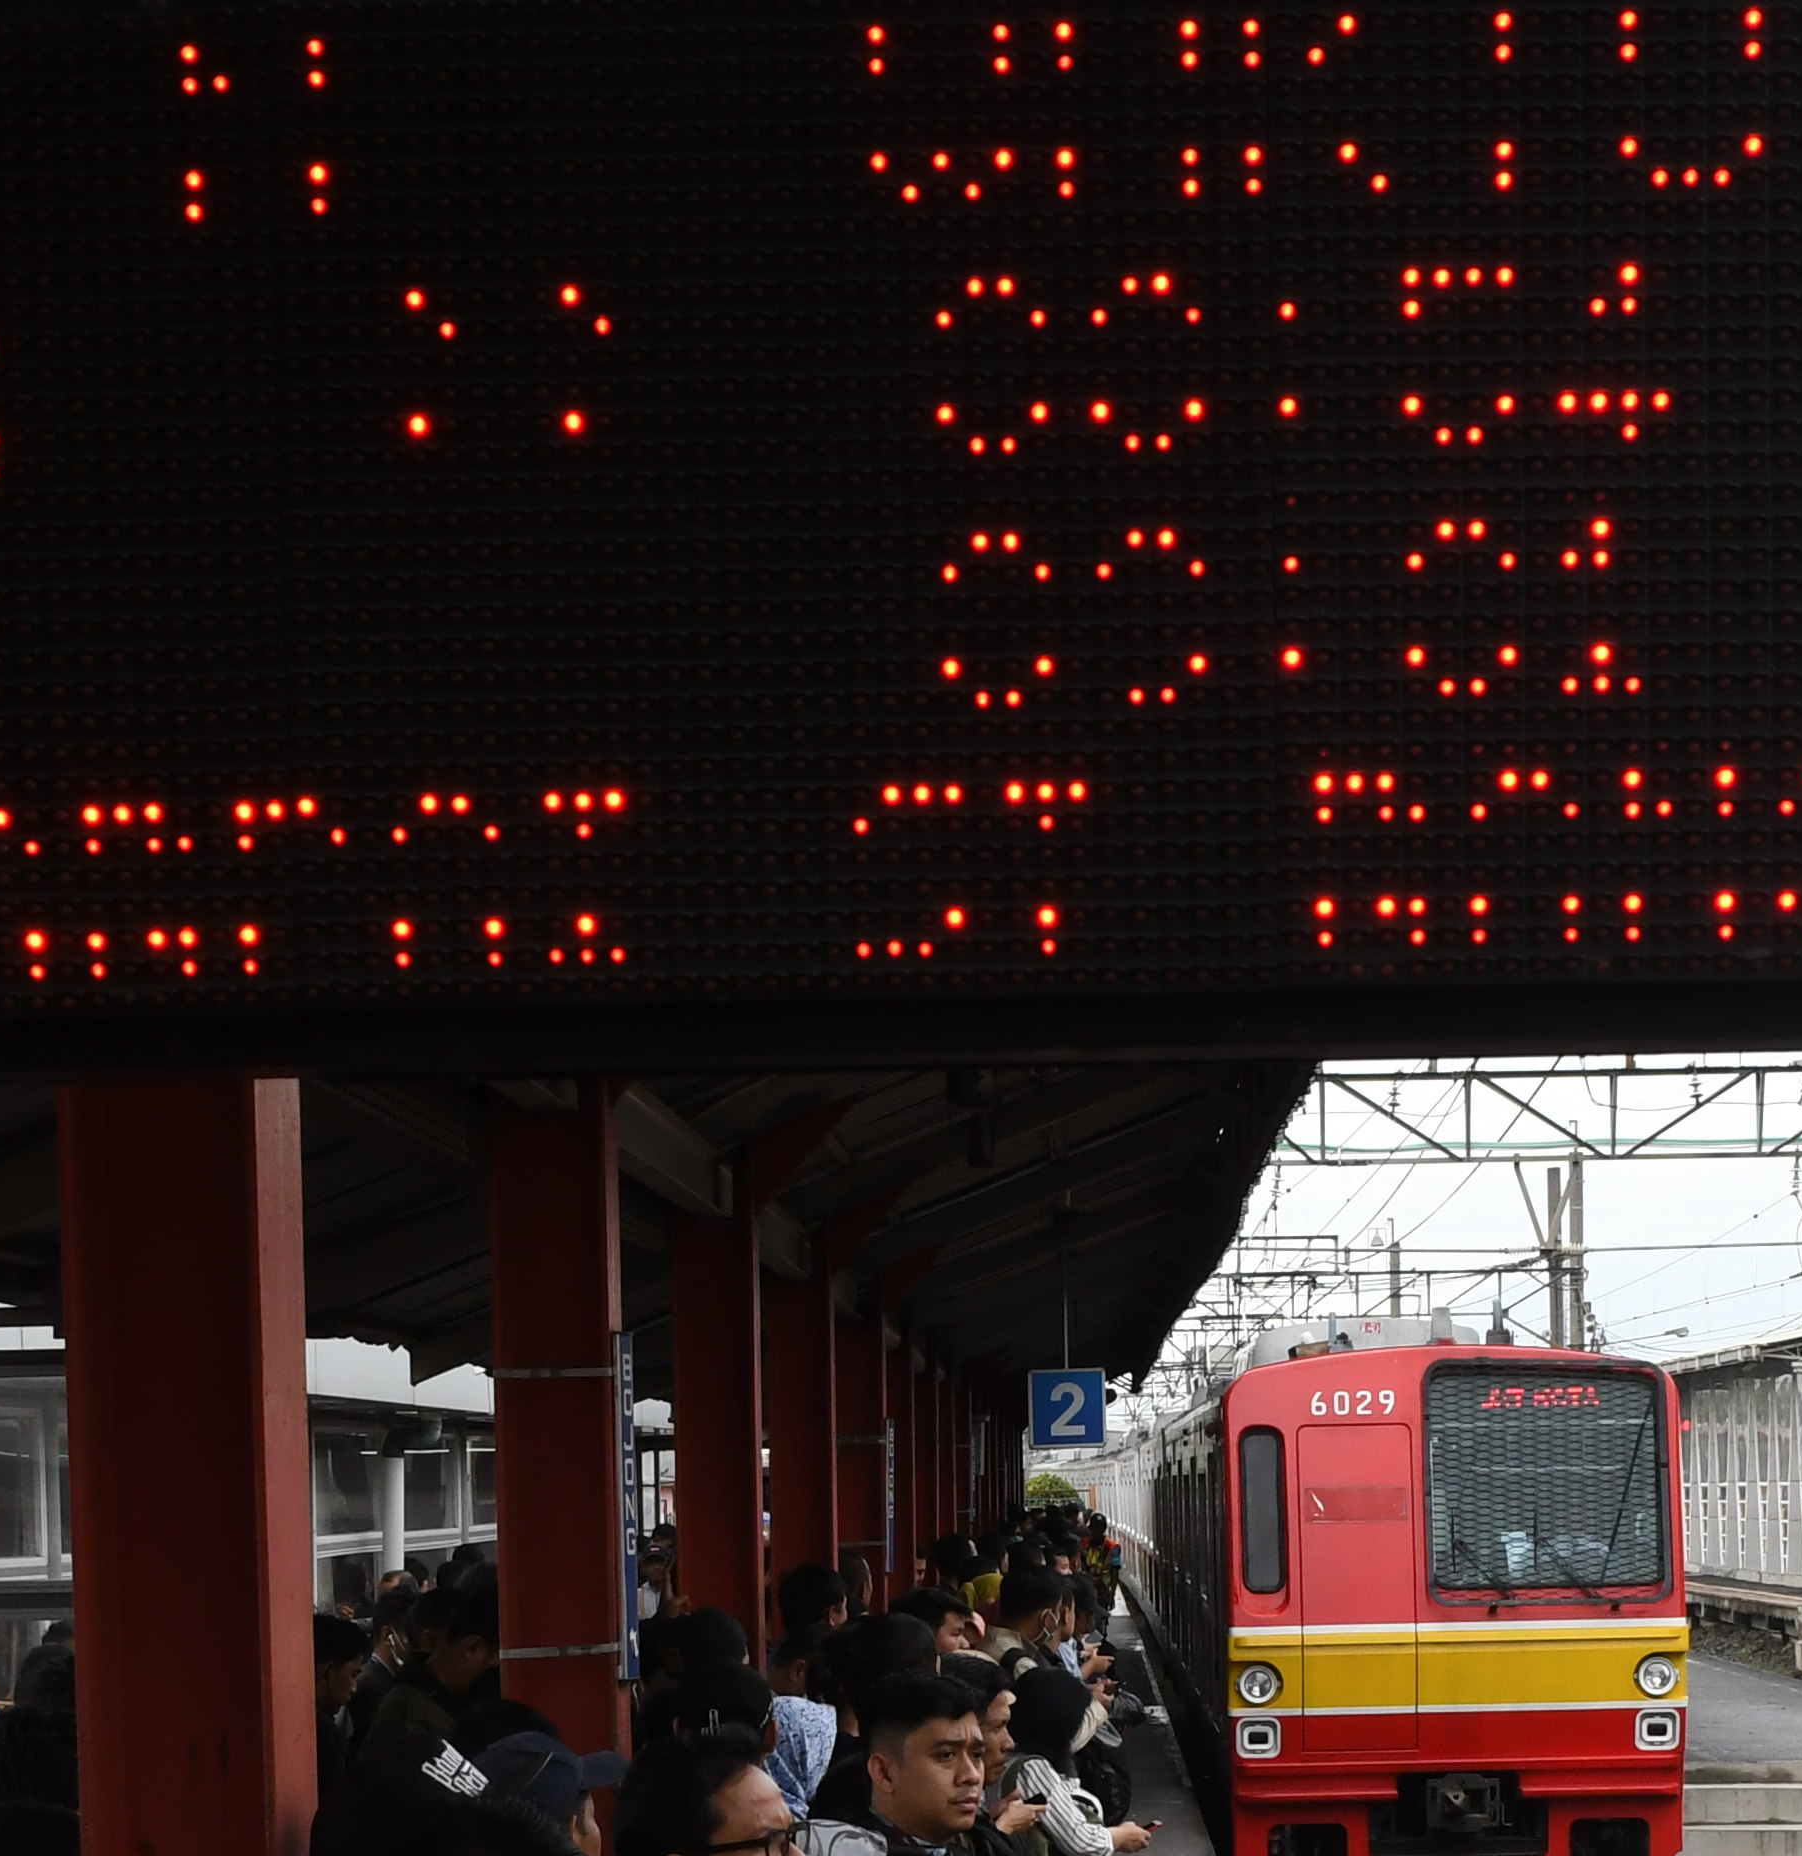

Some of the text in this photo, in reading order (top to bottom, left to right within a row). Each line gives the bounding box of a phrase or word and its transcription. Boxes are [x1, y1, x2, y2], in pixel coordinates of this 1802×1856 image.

[1050, 1381, 1086, 1437] 2
[1310, 1389, 1395, 1416] 6029
[621, 1352, 637, 1556] BOJONG
